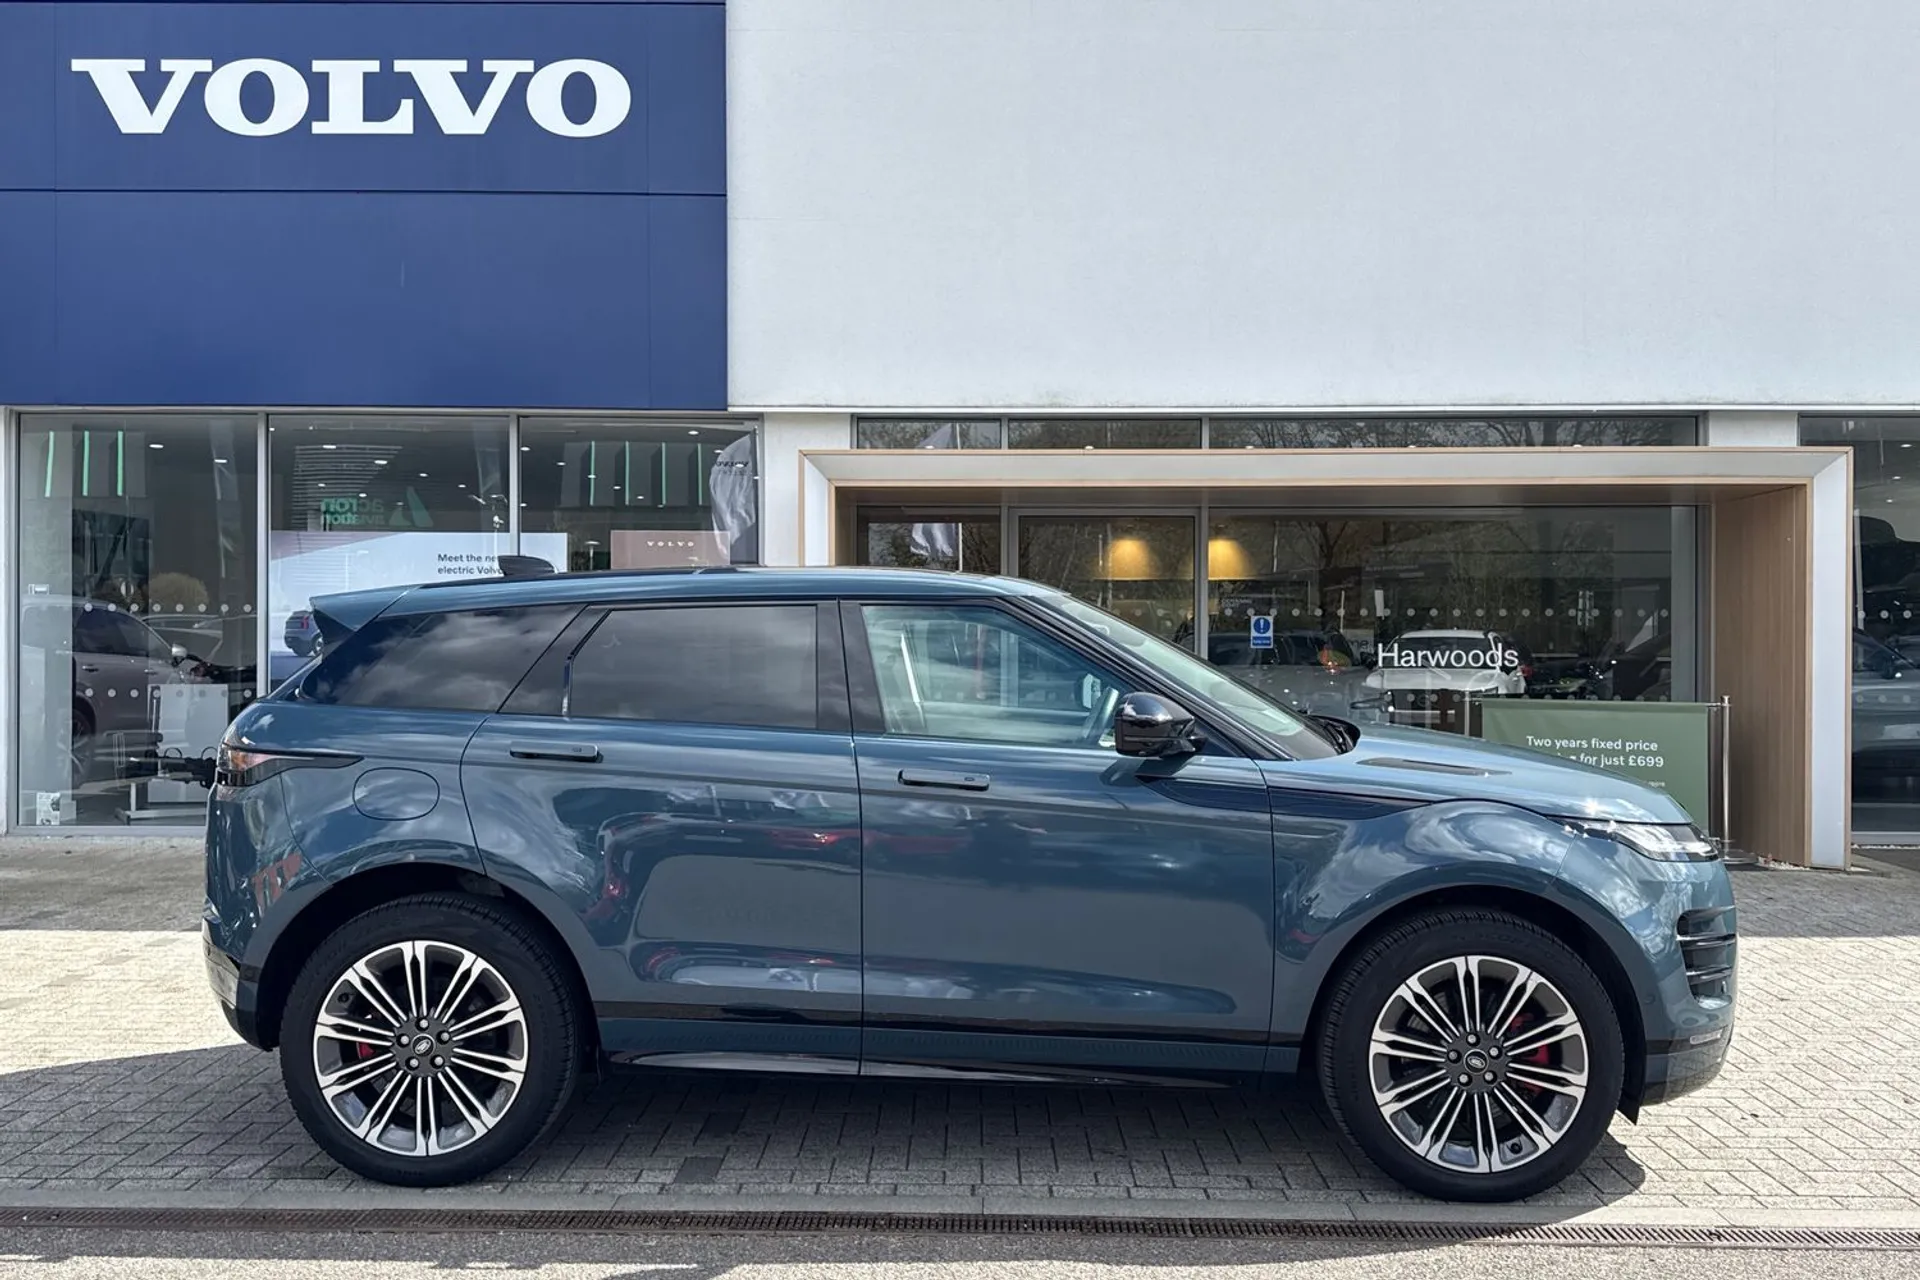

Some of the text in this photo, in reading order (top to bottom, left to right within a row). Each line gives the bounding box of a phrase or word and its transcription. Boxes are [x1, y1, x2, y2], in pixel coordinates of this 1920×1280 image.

[71, 58, 632, 138] VOLVO
[437, 553, 464, 562] Meet
[466, 553, 483, 562] the
[437, 565, 475, 574] electric
[1377, 642, 1520, 668] Harwoods
[1526, 735, 1659, 754] Two years fixed price
[1579, 752, 1598, 765] for
[1599, 754, 1625, 768] just
[1628, 755, 1665, 768] £699
